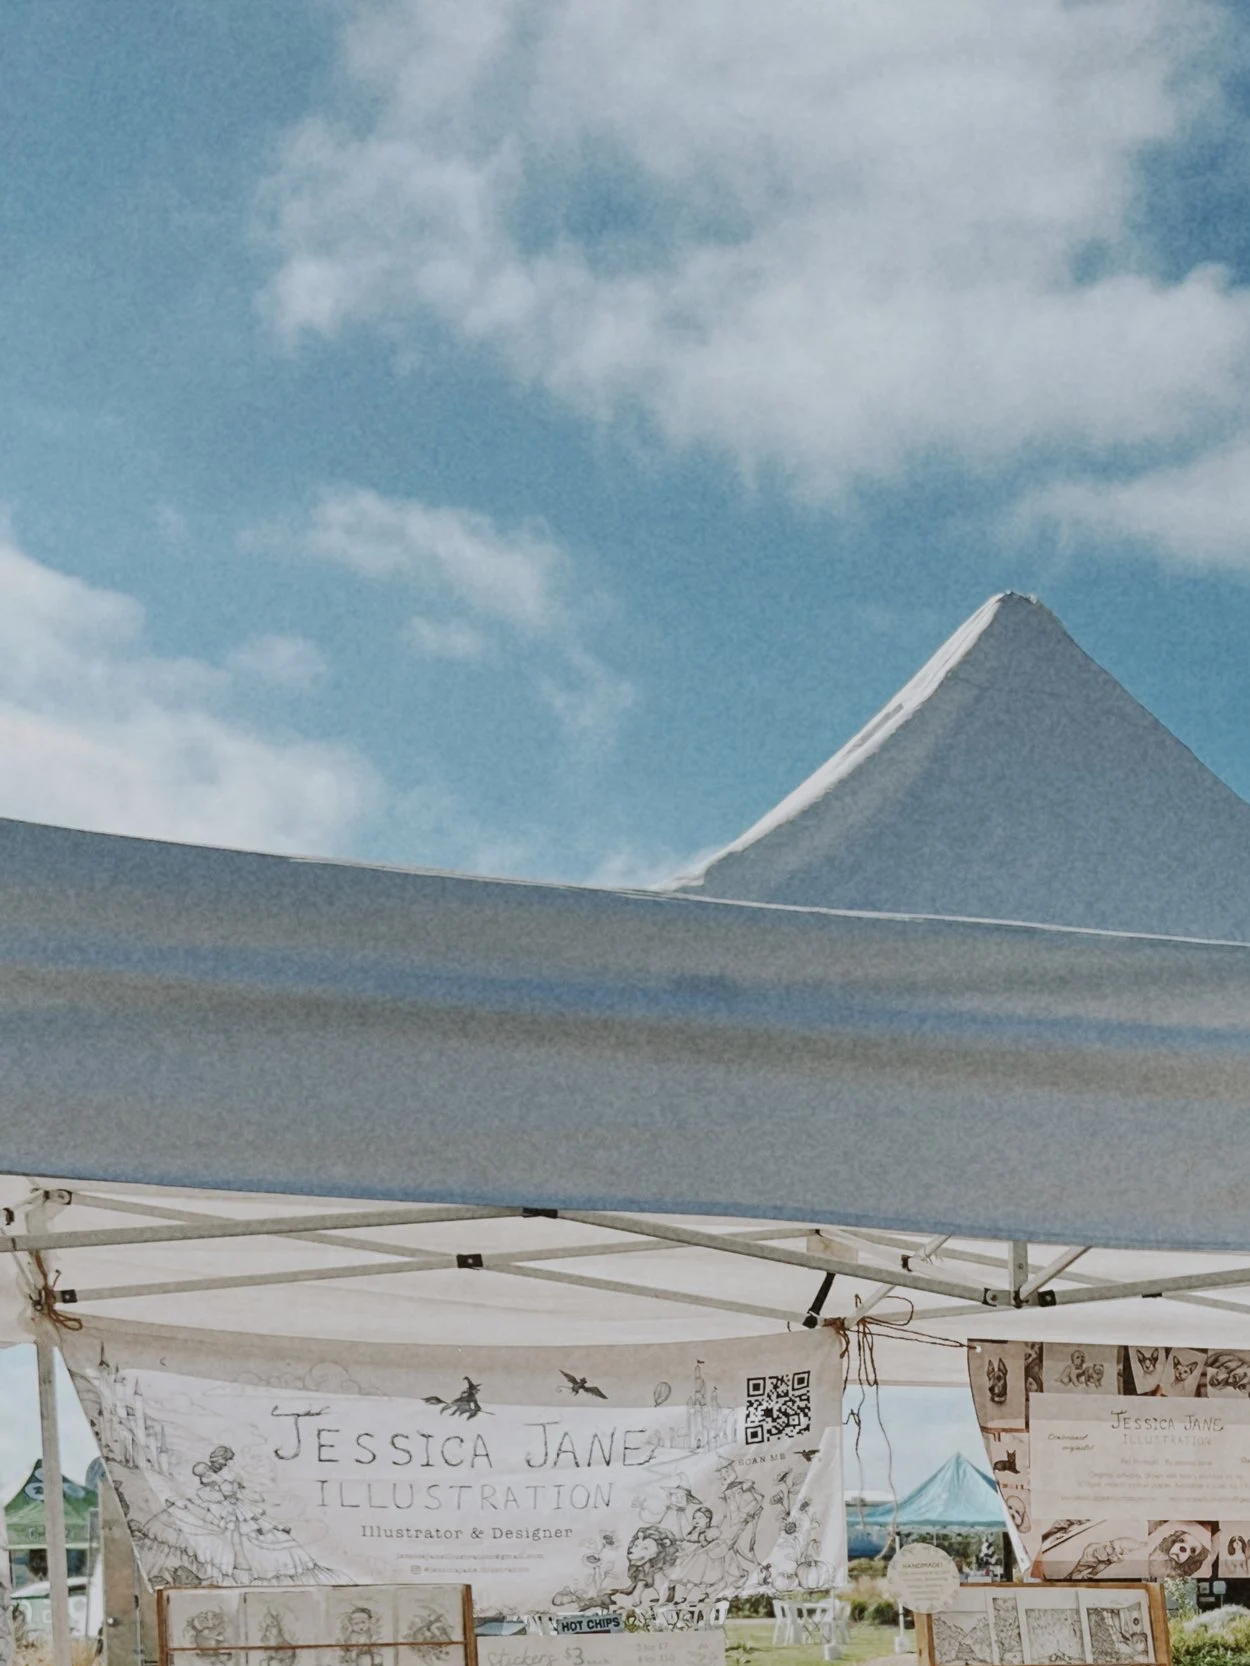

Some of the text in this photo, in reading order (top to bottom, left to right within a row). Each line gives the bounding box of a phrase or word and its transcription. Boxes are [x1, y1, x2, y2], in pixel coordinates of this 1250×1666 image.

[1110, 1410, 1225, 1432] JESSICA JANE
[271, 1405, 652, 1468] JESSICA JANE
[1123, 1434, 1213, 1446] ILLUSTRATION
[316, 1479, 614, 1510] ILLUSTRATION
[360, 1525, 573, 1541] Illustrator & Designer
[561, 1616, 621, 1633] HOT CHIPS
[564, 1647, 585, 1666] $3
